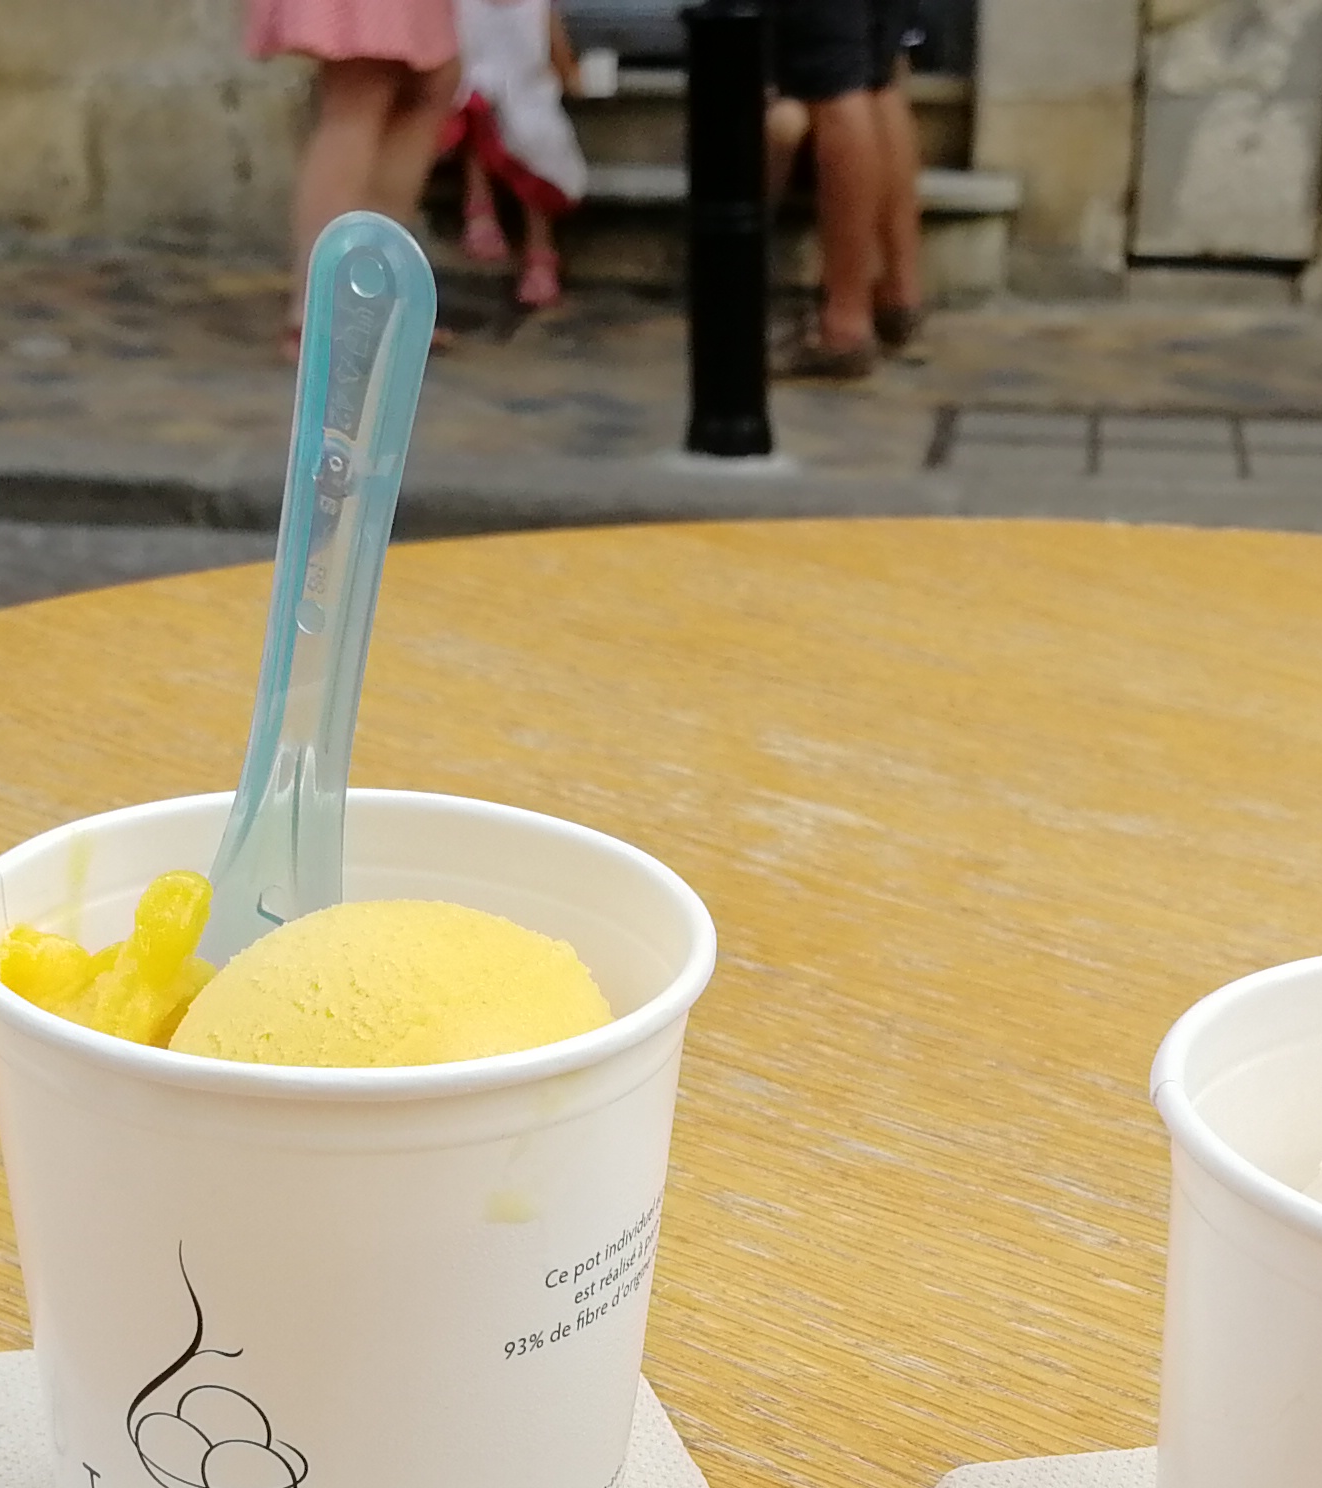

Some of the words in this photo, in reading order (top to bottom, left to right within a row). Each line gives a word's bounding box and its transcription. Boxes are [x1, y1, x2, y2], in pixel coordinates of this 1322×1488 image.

[545, 1268, 569, 1289] Ce
[574, 1251, 601, 1284] pot
[574, 1282, 596, 1304] est
[600, 1247, 637, 1291] réalisé
[504, 1330, 544, 1361] 93%
[549, 1322, 572, 1344] de
[576, 1301, 609, 1332] fibre
